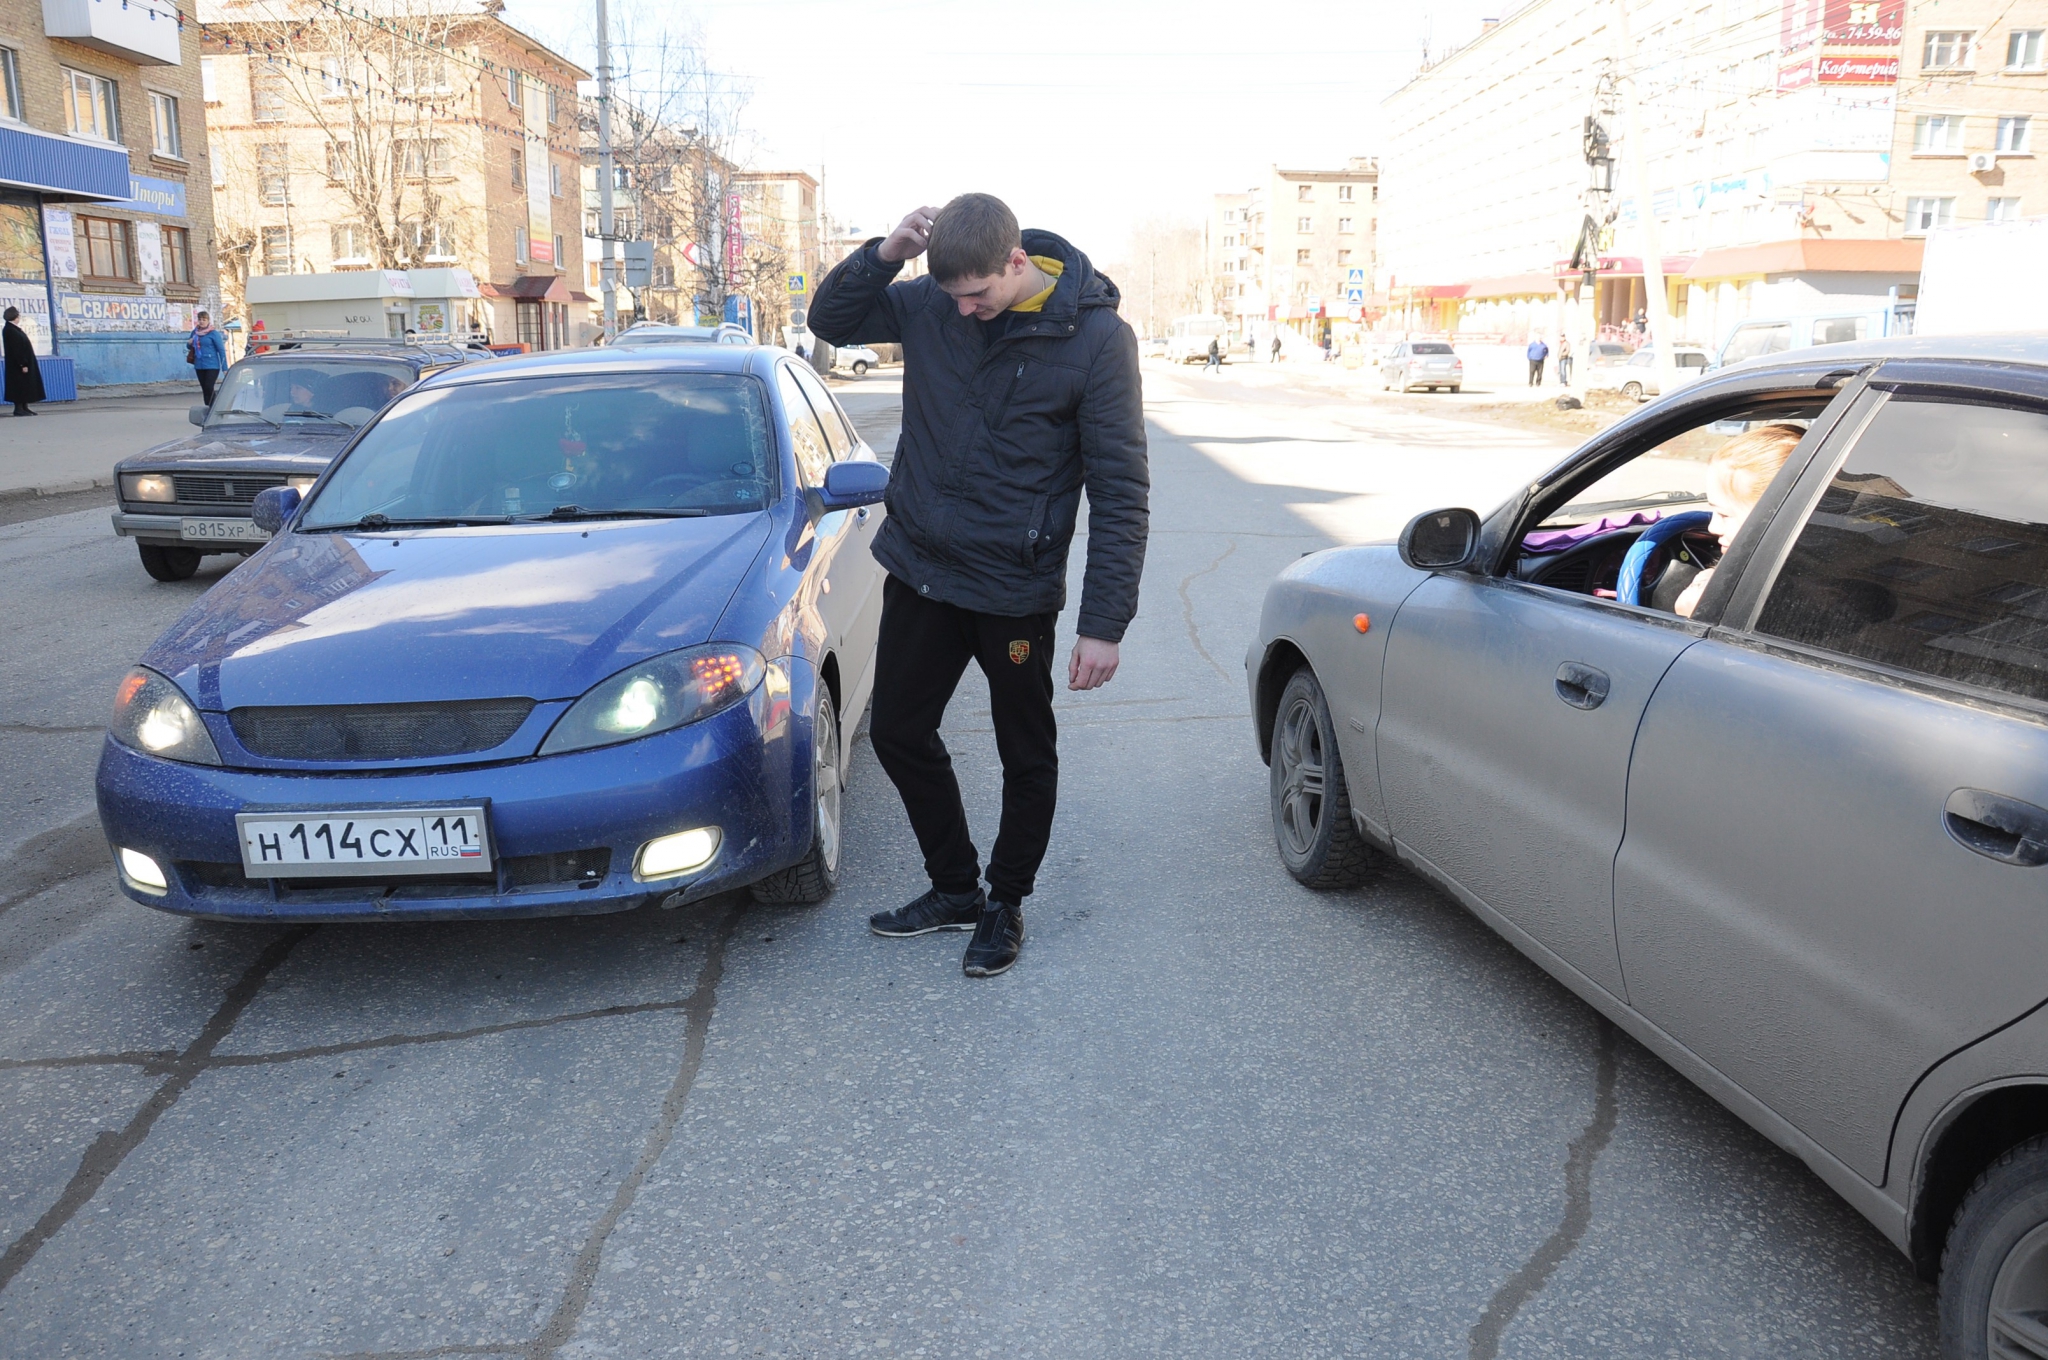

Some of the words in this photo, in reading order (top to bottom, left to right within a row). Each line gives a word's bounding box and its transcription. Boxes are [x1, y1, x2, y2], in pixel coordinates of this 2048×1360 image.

[1847, 26, 1902, 40] 74-59-86
[1818, 59, 1898, 79] Кафетерий
[130, 180, 175, 210] Шторы
[82, 301, 165, 320] СВАРОВСКИ
[431, 817, 469, 845] 11
[431, 845, 459, 857] RUS
